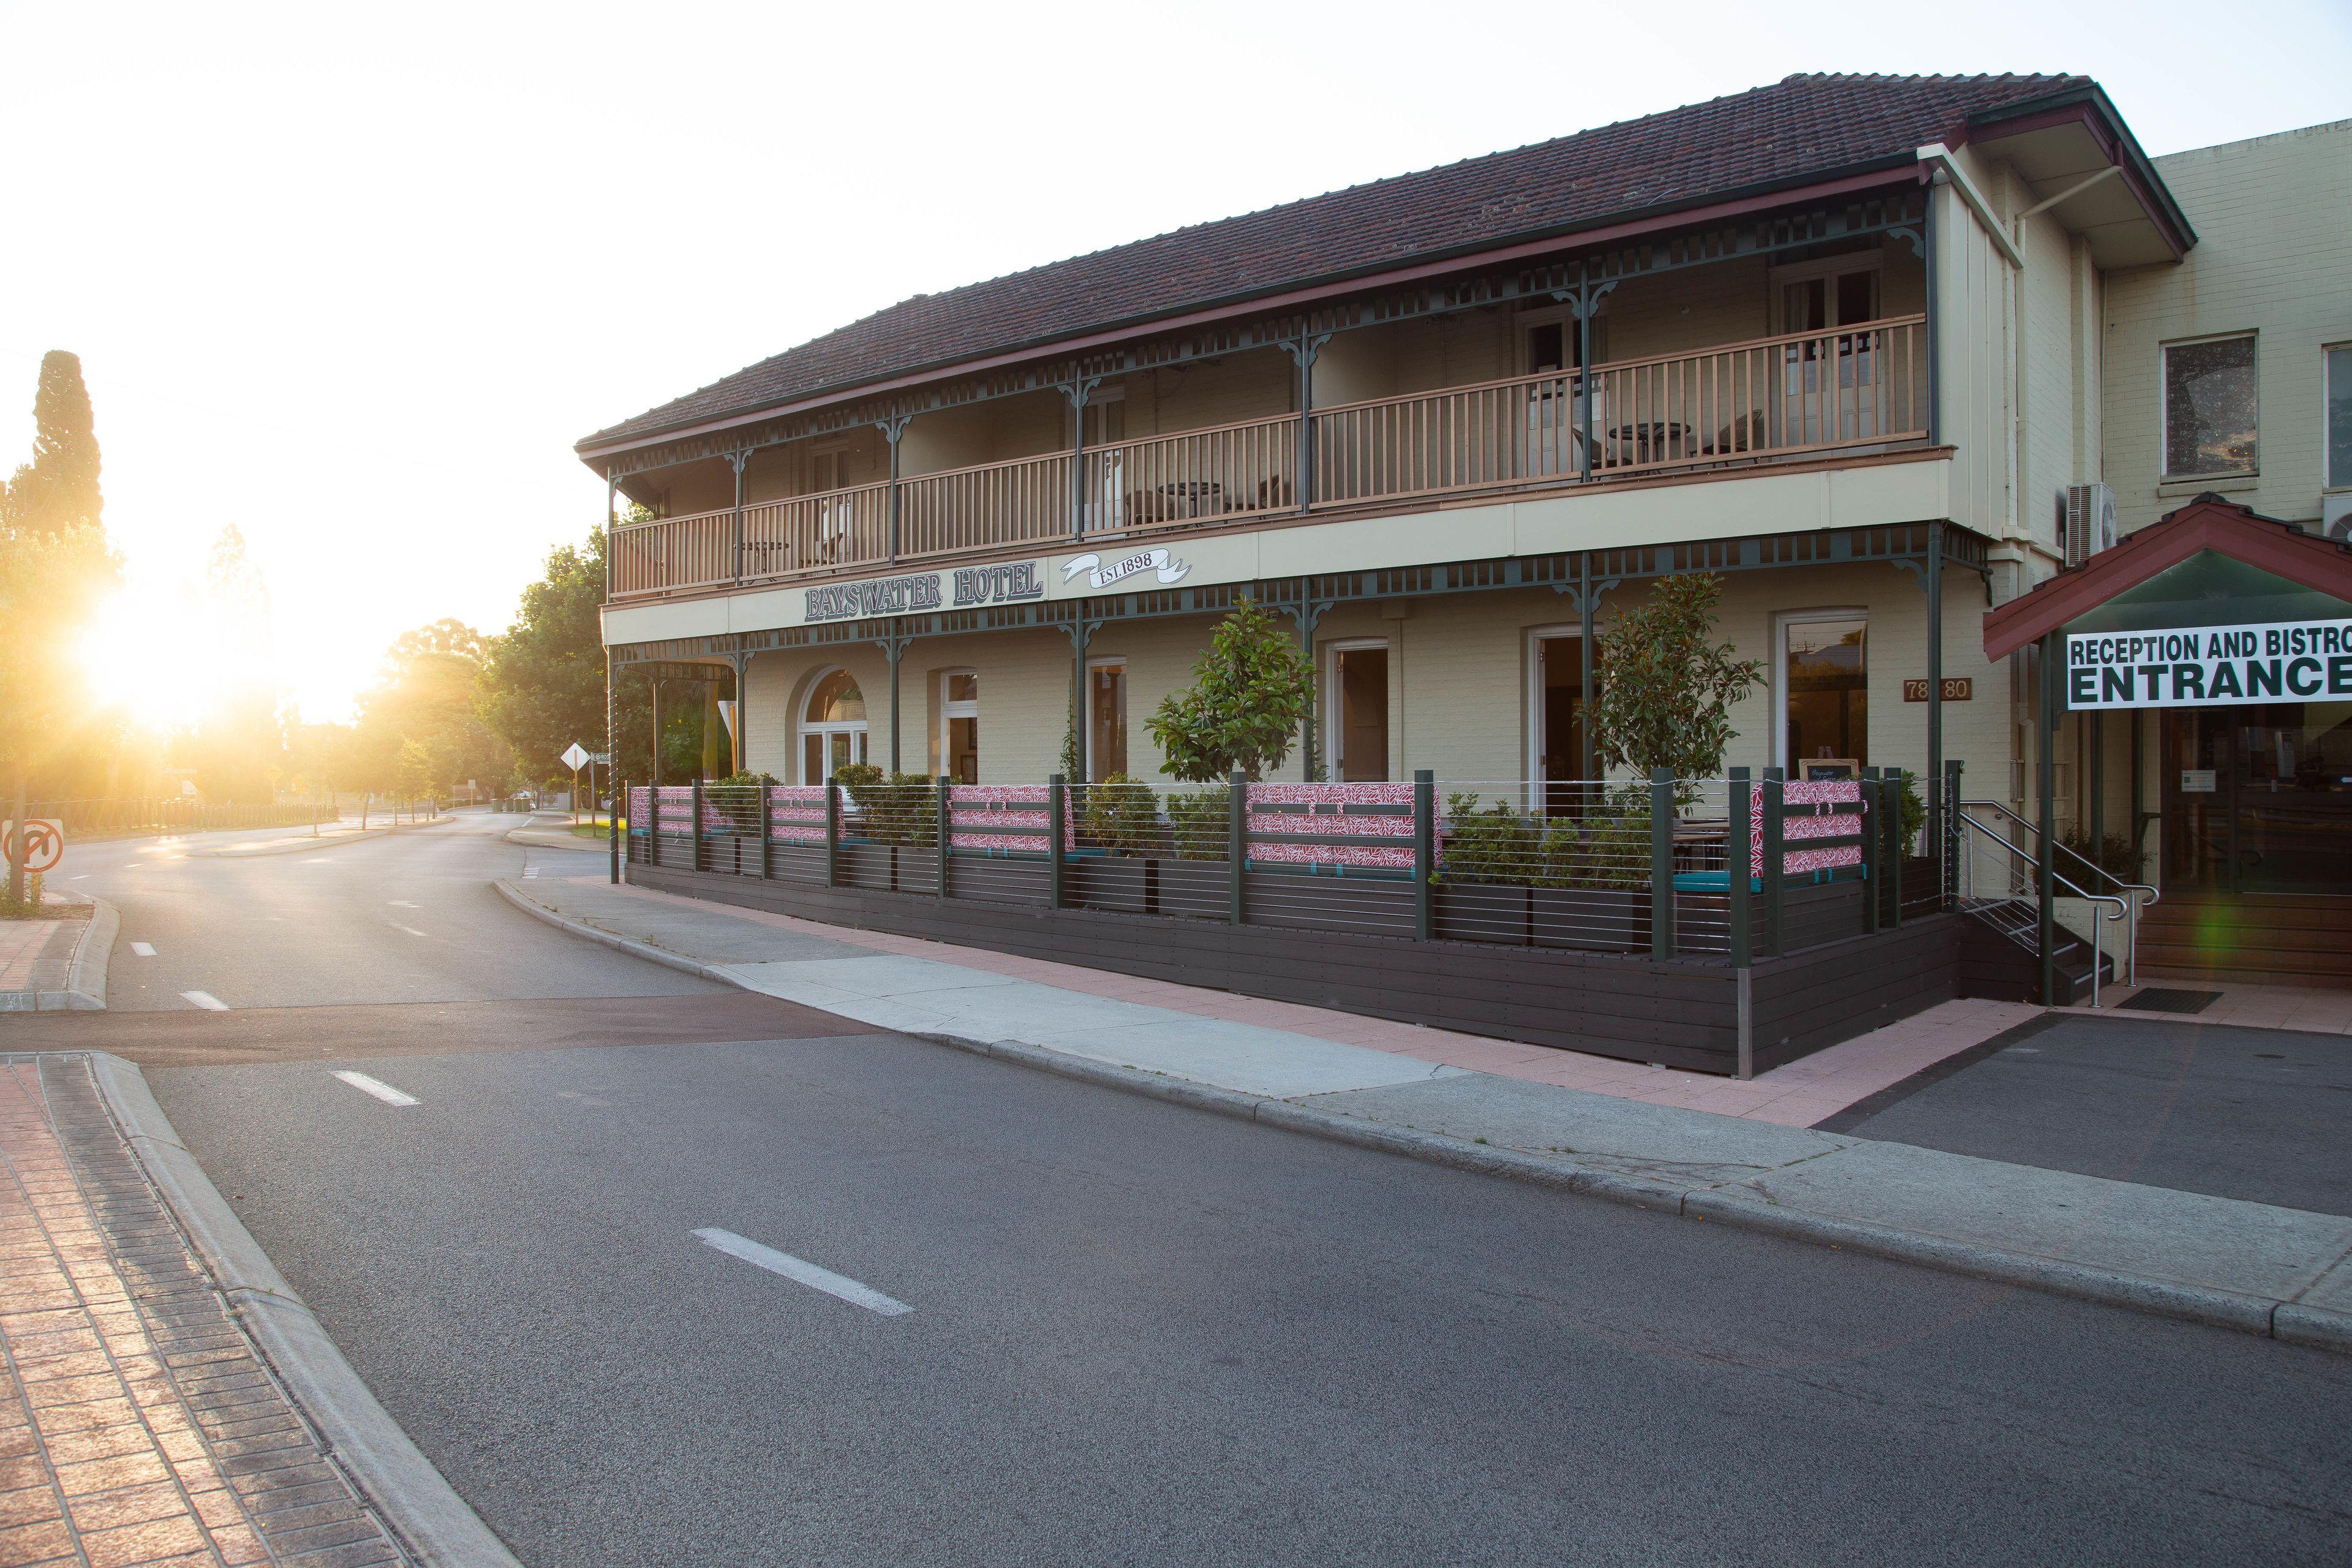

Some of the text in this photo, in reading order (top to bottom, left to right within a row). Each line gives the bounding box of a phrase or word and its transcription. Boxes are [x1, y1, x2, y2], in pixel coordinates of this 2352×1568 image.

[1100, 553, 1152, 585] EST.1898
[805, 561, 1044, 622] BAYSWATER HOTEL
[2071, 625, 2352, 665] RECEPTION AND BISTRO
[1907, 680, 1967, 698] 78 80
[2071, 656, 2352, 703] ENTRANCE
